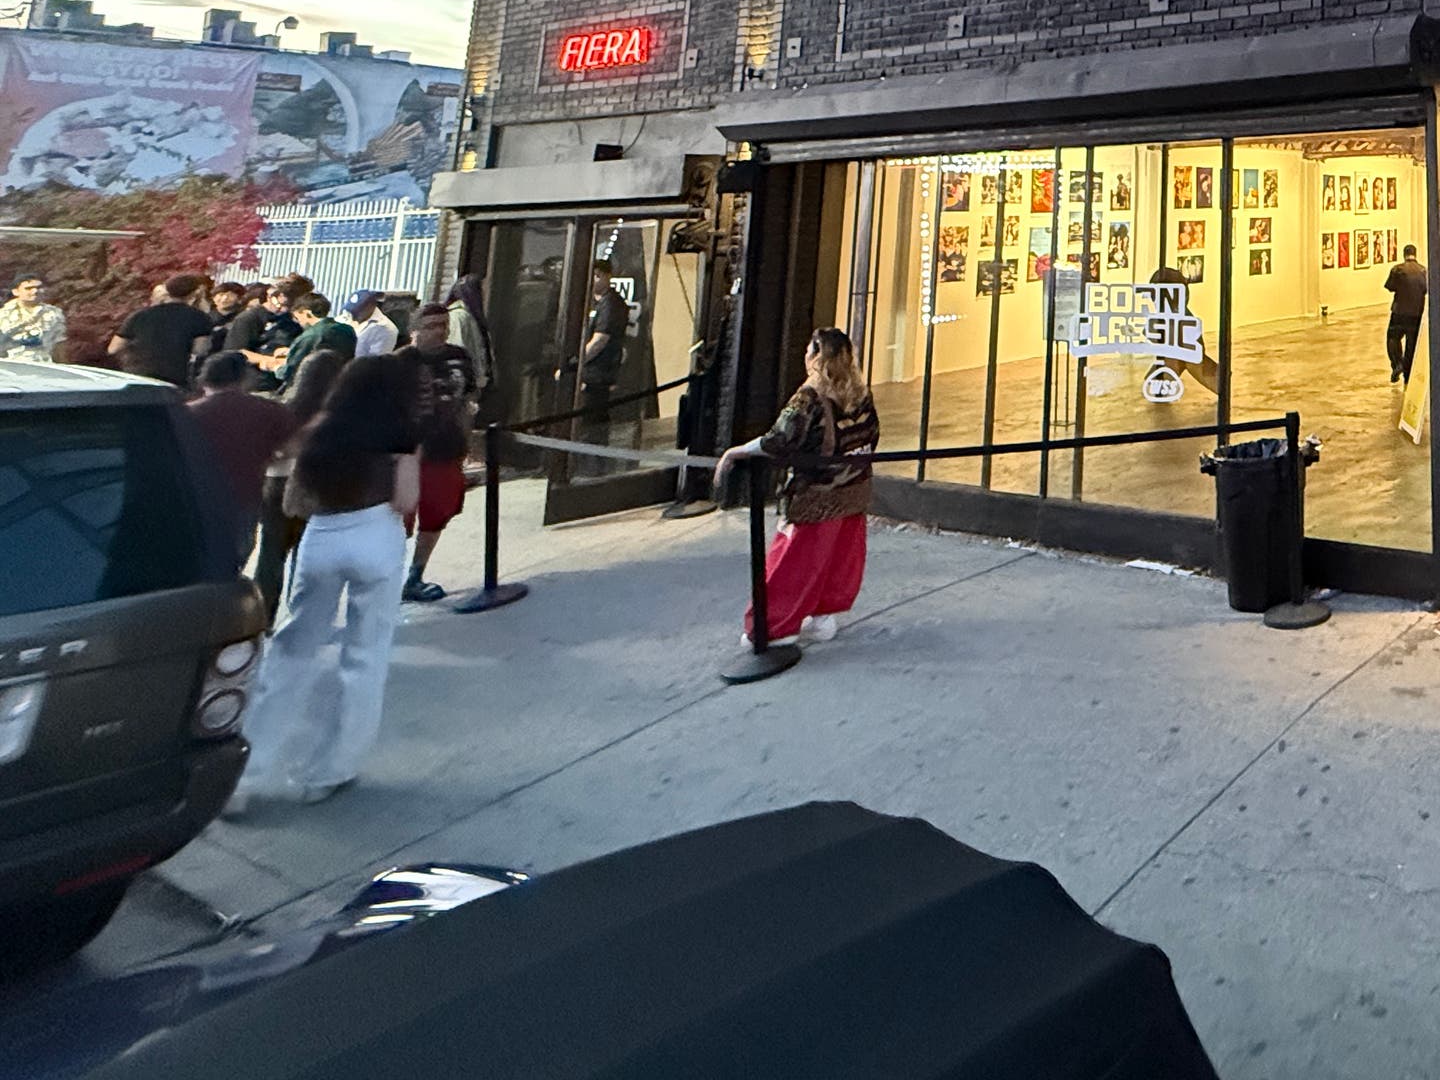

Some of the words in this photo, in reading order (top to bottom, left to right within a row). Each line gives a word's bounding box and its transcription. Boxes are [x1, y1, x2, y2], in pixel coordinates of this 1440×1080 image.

[561, 28, 641, 70] FIERA
[1087, 284, 1183, 316] BORN
[1073, 315, 1200, 352] CLASSIC
[1150, 378, 1181, 397] WSS
